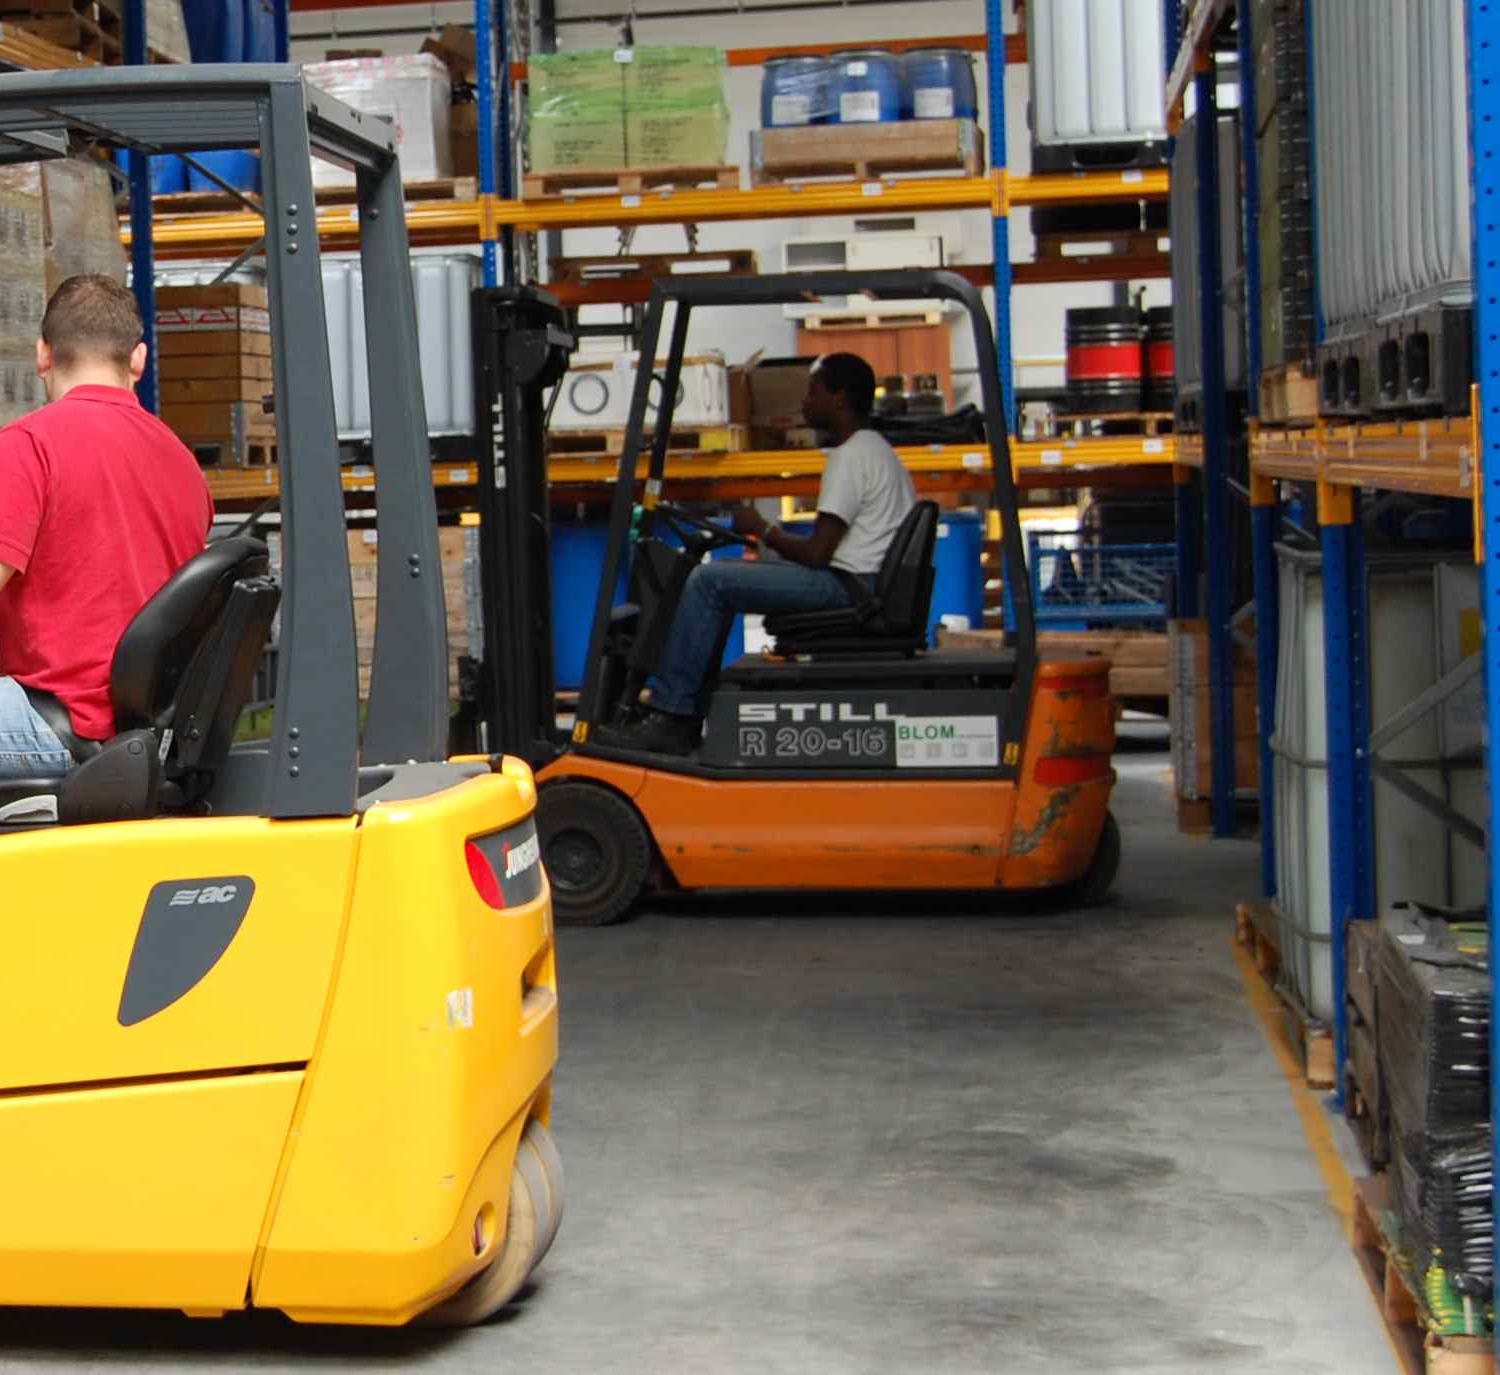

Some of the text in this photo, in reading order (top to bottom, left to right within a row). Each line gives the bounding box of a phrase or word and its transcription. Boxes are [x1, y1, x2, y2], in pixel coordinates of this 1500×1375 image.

[491, 392, 506, 488] STILL
[739, 703, 906, 721] STILL
[739, 726, 887, 756] R 20-16
[899, 725, 955, 739] BLOM
